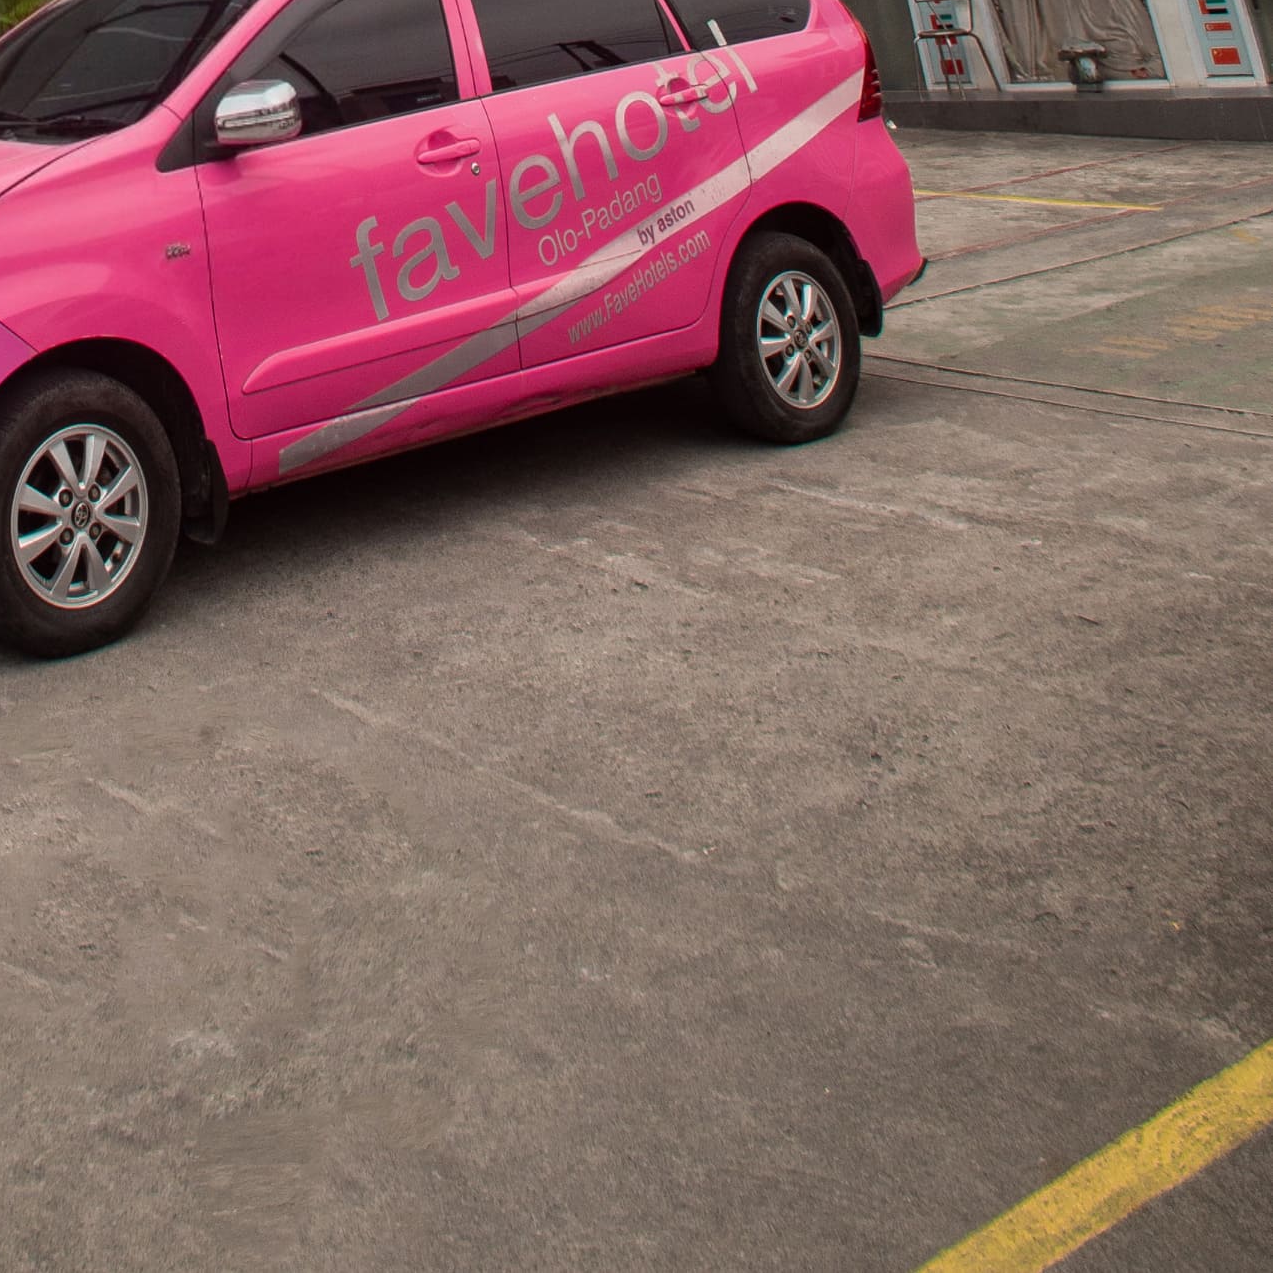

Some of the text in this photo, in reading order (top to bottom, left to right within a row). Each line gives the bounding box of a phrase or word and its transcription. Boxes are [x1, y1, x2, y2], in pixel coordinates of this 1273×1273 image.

[349, 18, 759, 322] favehotel
[538, 172, 664, 267] Olo-Padang
[637, 199, 696, 246] by aston
[567, 229, 712, 345] www.FaveHotels.com
